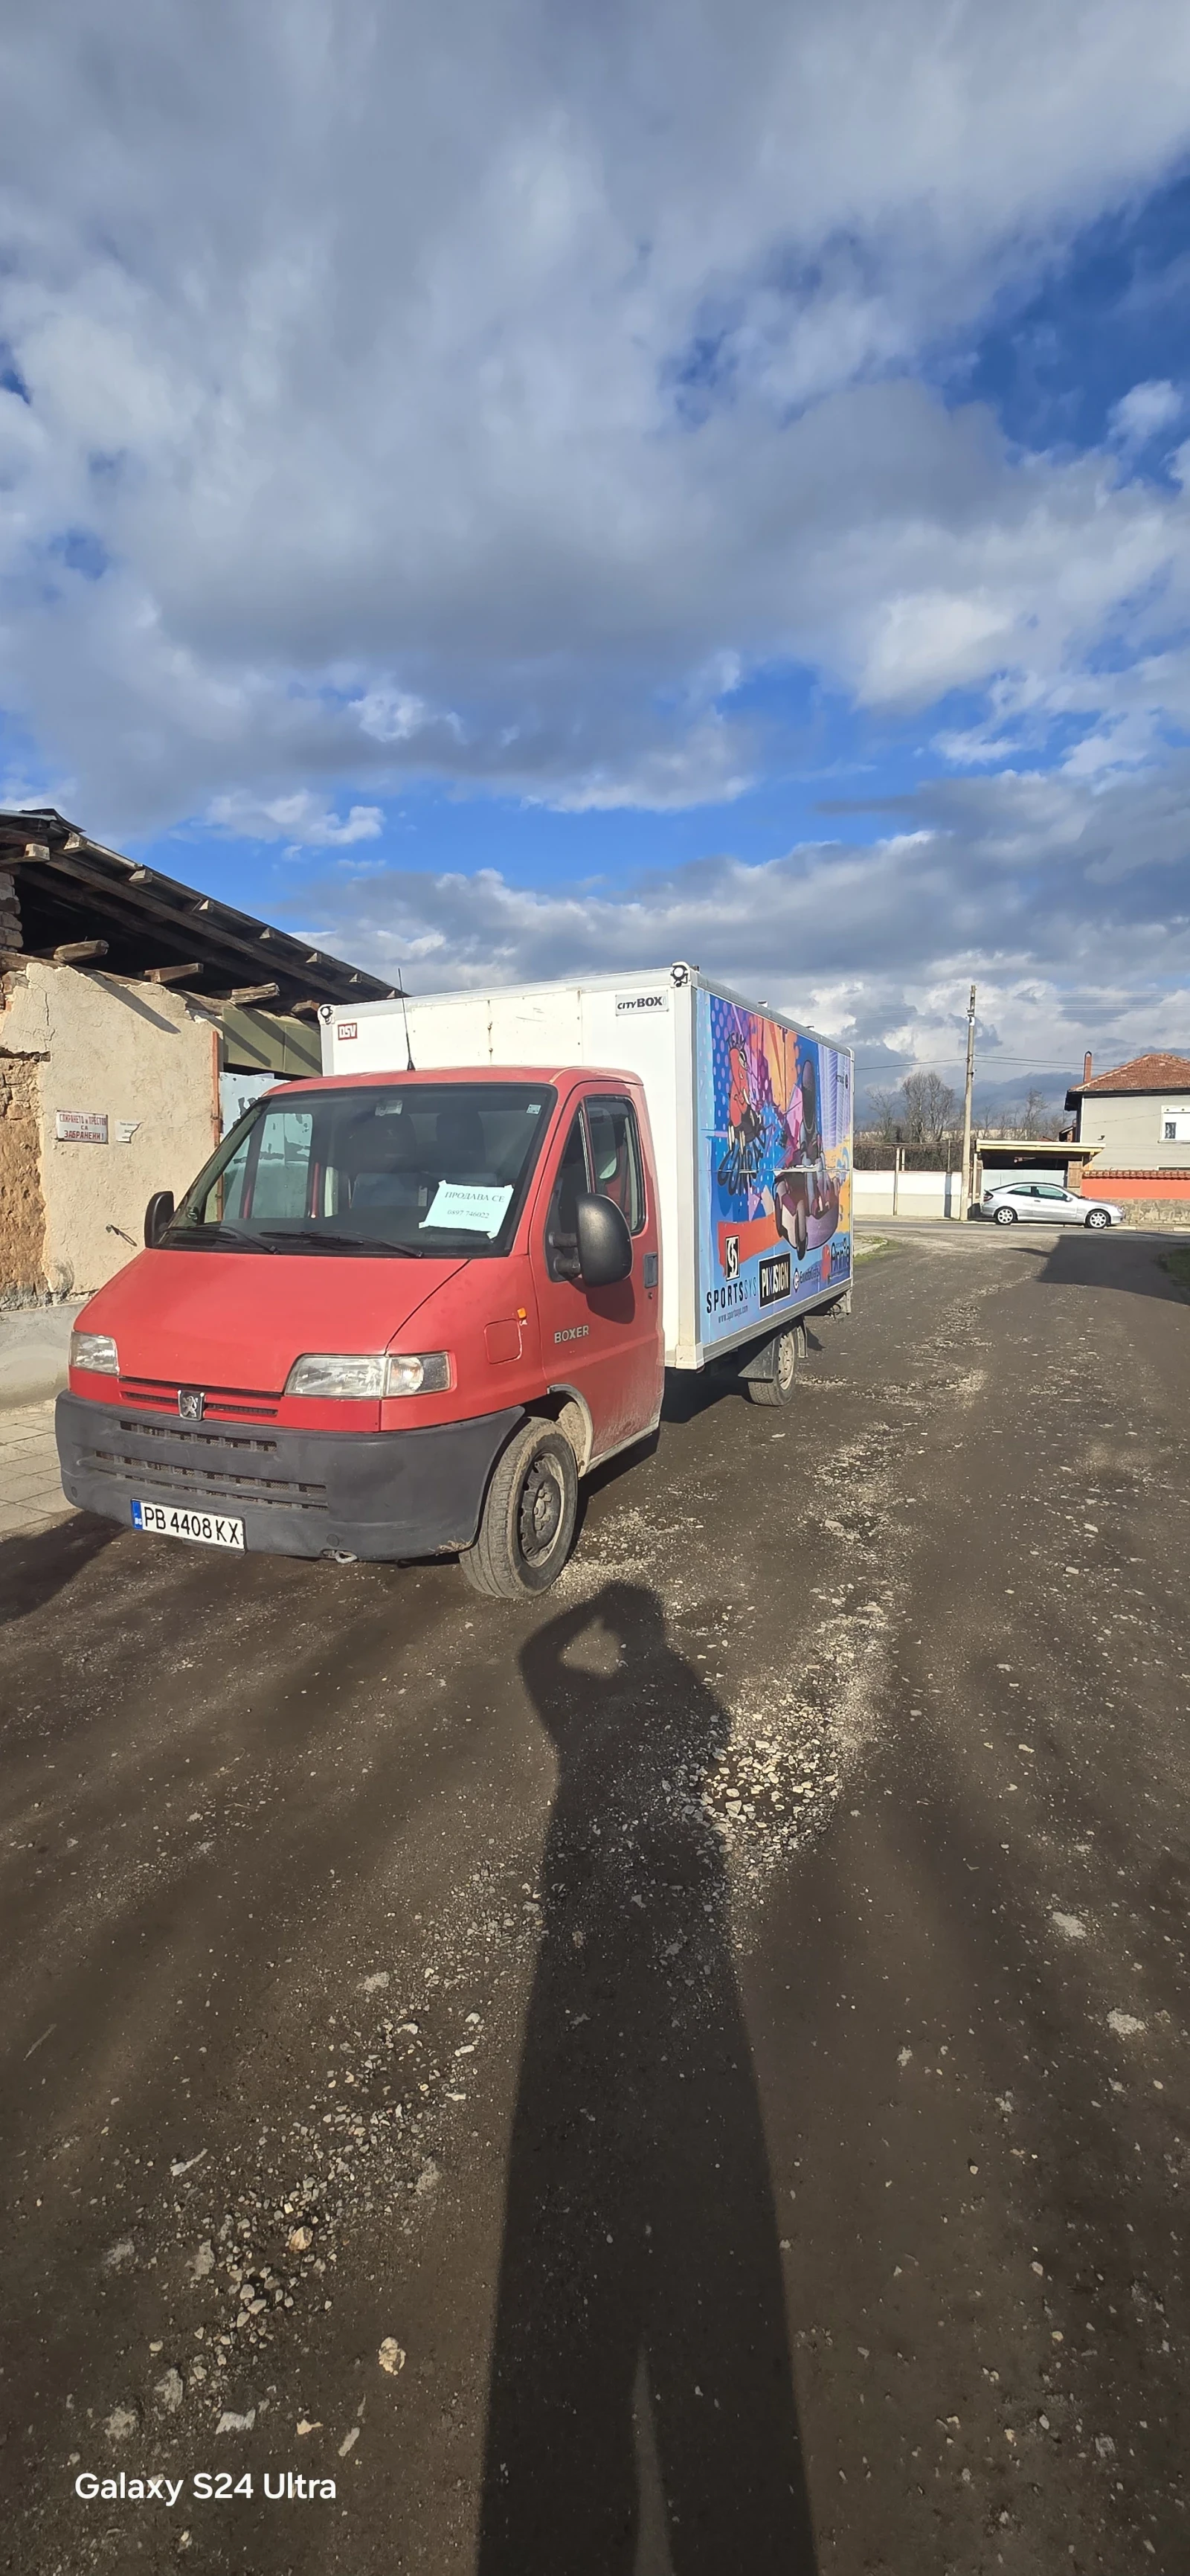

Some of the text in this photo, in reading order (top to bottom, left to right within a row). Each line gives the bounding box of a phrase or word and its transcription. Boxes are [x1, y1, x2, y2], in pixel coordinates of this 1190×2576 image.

[338, 1025, 356, 1038] DSV
[445, 1192, 505, 1203] ПРОДАВА СЕ
[554, 1325, 589, 1343] BOXER
[170, 1512, 212, 1538] 4408
